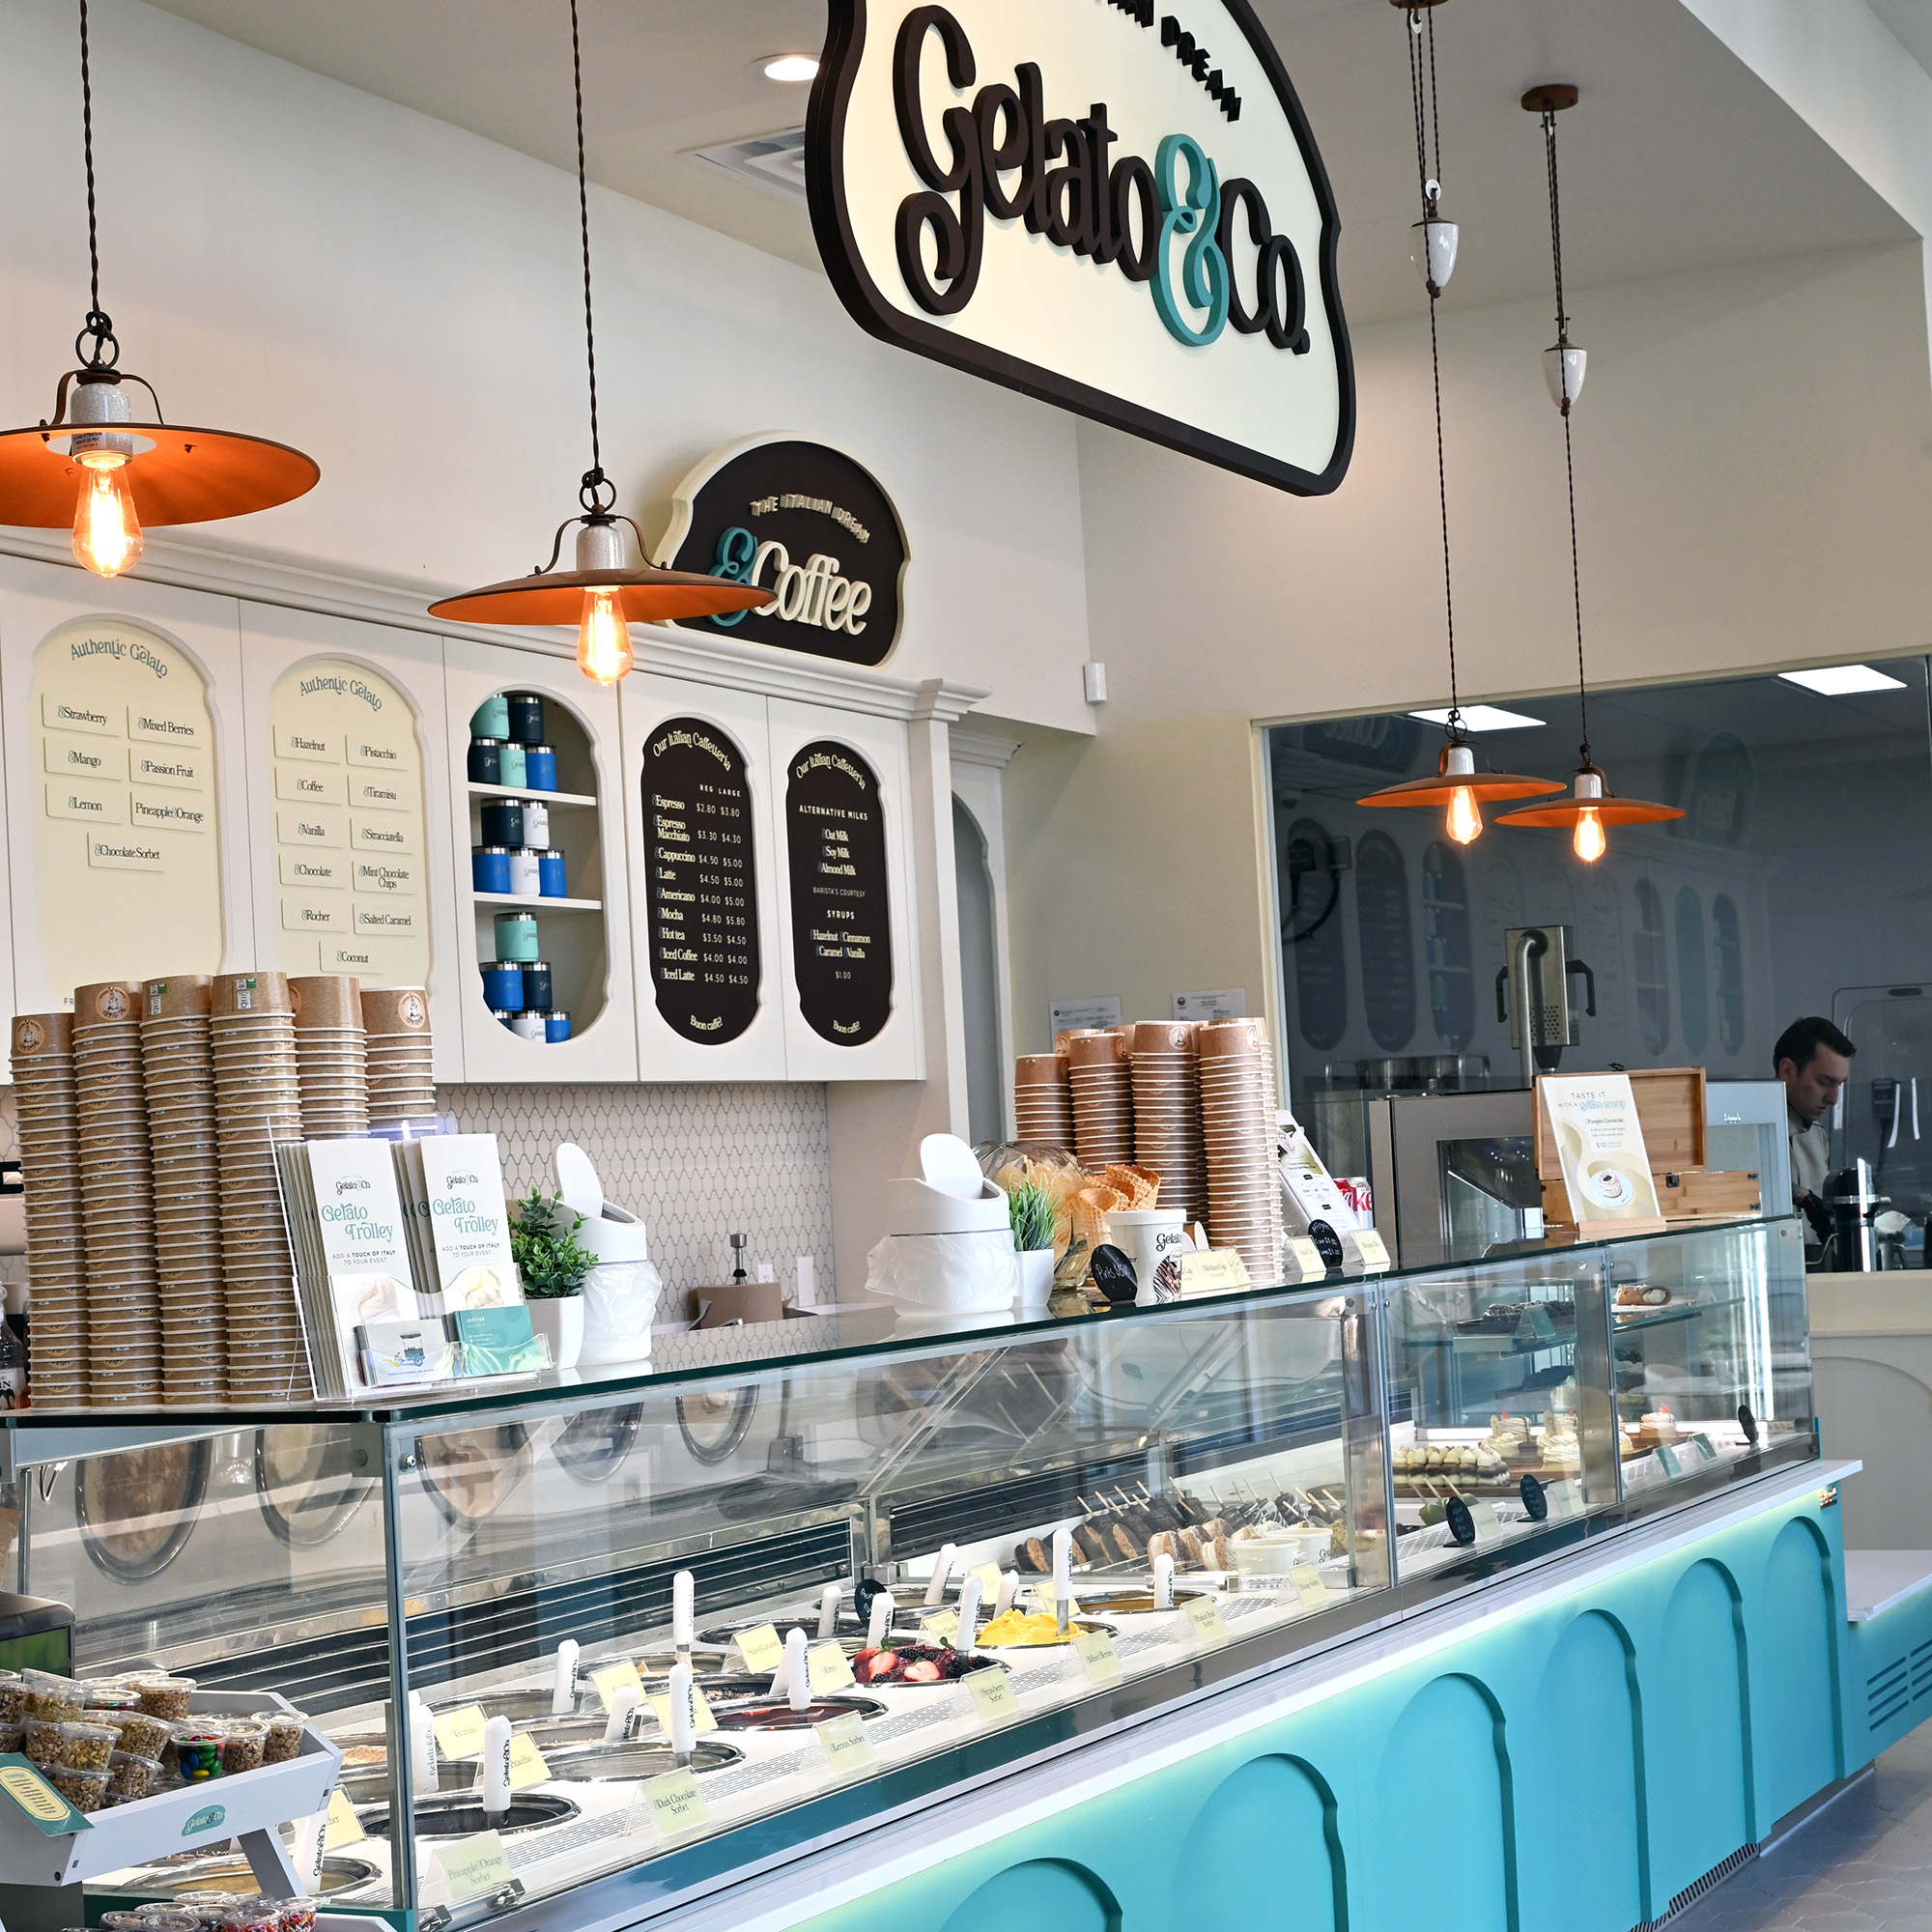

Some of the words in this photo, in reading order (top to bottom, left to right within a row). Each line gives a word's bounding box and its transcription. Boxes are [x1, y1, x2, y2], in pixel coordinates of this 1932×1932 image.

[750, 496, 779, 517] THE
[780, 494, 833, 515] ITALIAN
[831, 506, 870, 544] DREAM
[71, 639, 127, 661] Authentic
[299, 675, 348, 696] Authentic
[167, 722, 194, 737] Berries
[653, 738, 668, 757] Our
[668, 729, 693, 748] Italian
[176, 764, 194, 778] Fruit
[796, 759, 810, 779] Our
[699, 783, 714, 793] REG
[718, 785, 741, 798] LARGE
[696, 803, 716, 814] $2.80
[721, 807, 740, 817] $3.80
[799, 804, 845, 818] ALTERNATIVE
[847, 810, 868, 821] MILKS
[658, 827, 690, 842] Macchiato
[697, 830, 718, 841] $3.30
[722, 833, 742, 844] $4.30
[836, 830, 849, 841] Milk
[136, 846, 160, 860] Sorbet
[837, 847, 850, 859] Milk
[698, 854, 719, 866] $4.50
[723, 857, 743, 868] $5.00
[379, 867, 410, 880] Chocolate
[699, 873, 720, 885] $4.50
[724, 876, 744, 888] $5.00
[378, 877, 397, 891] Chips
[812, 887, 839, 896] BARISTA'S
[839, 888, 866, 897] COURTESY
[700, 895, 721, 905] $4.00
[724, 896, 745, 907] $5.00
[385, 914, 412, 926] Caramel
[701, 913, 722, 924] $4.80
[725, 916, 746, 926] $5.80
[827, 909, 855, 920] SYRUPS
[702, 933, 723, 944] $3.50
[726, 935, 747, 946] $4.50
[677, 949, 698, 962] Coffee
[703, 952, 724, 963] $4.00
[727, 954, 748, 965] $4.00
[678, 969, 696, 981] Latte
[704, 973, 724, 983] $4.50
[728, 974, 749, 984] $4.50
[836, 971, 852, 980] $1.00
[690, 1014, 707, 1030] Buon
[1579, 1099, 1603, 1112] gelato
[1604, 1100, 1626, 1110] scoop
[321, 1203, 368, 1222] Gelato
[432, 1197, 475, 1215] Gelato
[345, 1222, 393, 1243] Trolley
[454, 1215, 498, 1236] Trolley
[848, 1735, 866, 1747] Sorbet
[670, 1789, 696, 1804] Chocolate
[670, 1803, 689, 1815] Sorbet
[469, 1873, 491, 1885] Sorbet
